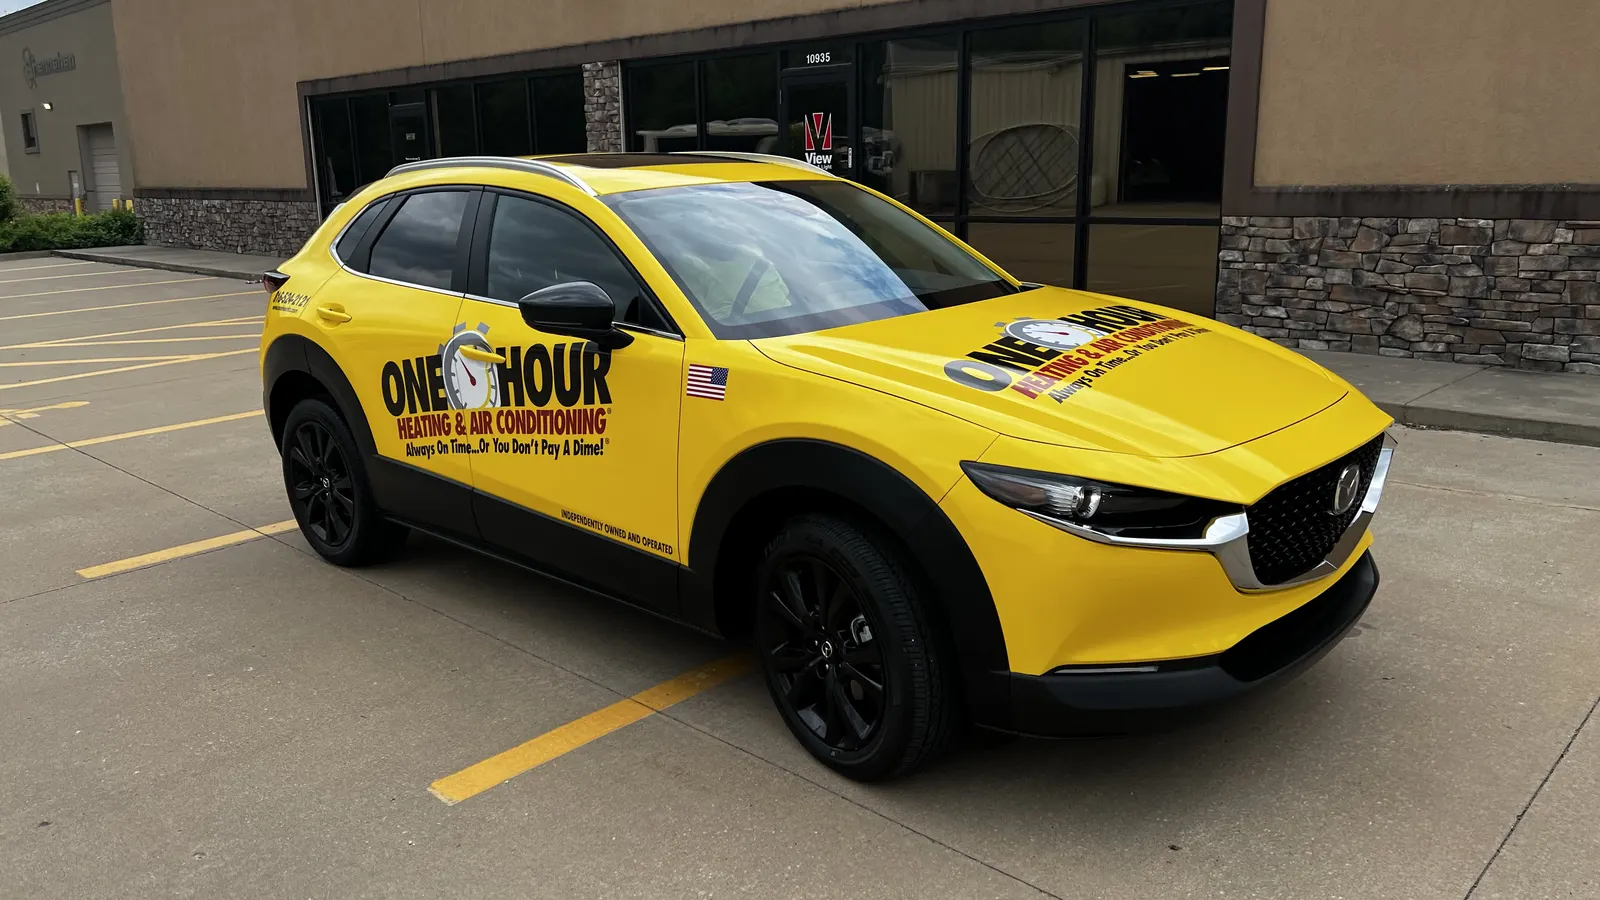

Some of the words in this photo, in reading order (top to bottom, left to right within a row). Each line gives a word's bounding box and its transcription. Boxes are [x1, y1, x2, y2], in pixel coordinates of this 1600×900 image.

[806, 52, 831, 64] 10935
[804, 152, 833, 164] View
[943, 335, 1064, 392] ONE
[1057, 305, 1173, 335] HOUR
[1075, 348, 1105, 359] &
[1089, 338, 1129, 354] AIR
[381, 354, 449, 417] ONE
[496, 340, 613, 408] HOUR
[1010, 354, 1090, 399] HEATING
[1047, 375, 1093, 404] Always
[1083, 367, 1107, 378] On
[1133, 342, 1159, 352] You
[396, 412, 452, 440] HEATING
[454, 411, 467, 436] &
[469, 410, 494, 435] AIR
[406, 442, 435, 460] Always
[436, 439, 449, 455] On
[492, 437, 510, 453] You
[511, 438, 539, 455] Don't
[541, 438, 560, 460] Pay
[562, 439, 571, 456] A
[560, 508, 604, 532] INDEPENDENTLY
[604, 523, 627, 540] OWNED
[627, 531, 641, 545] AND
[641, 536, 673, 555] OPERATED
